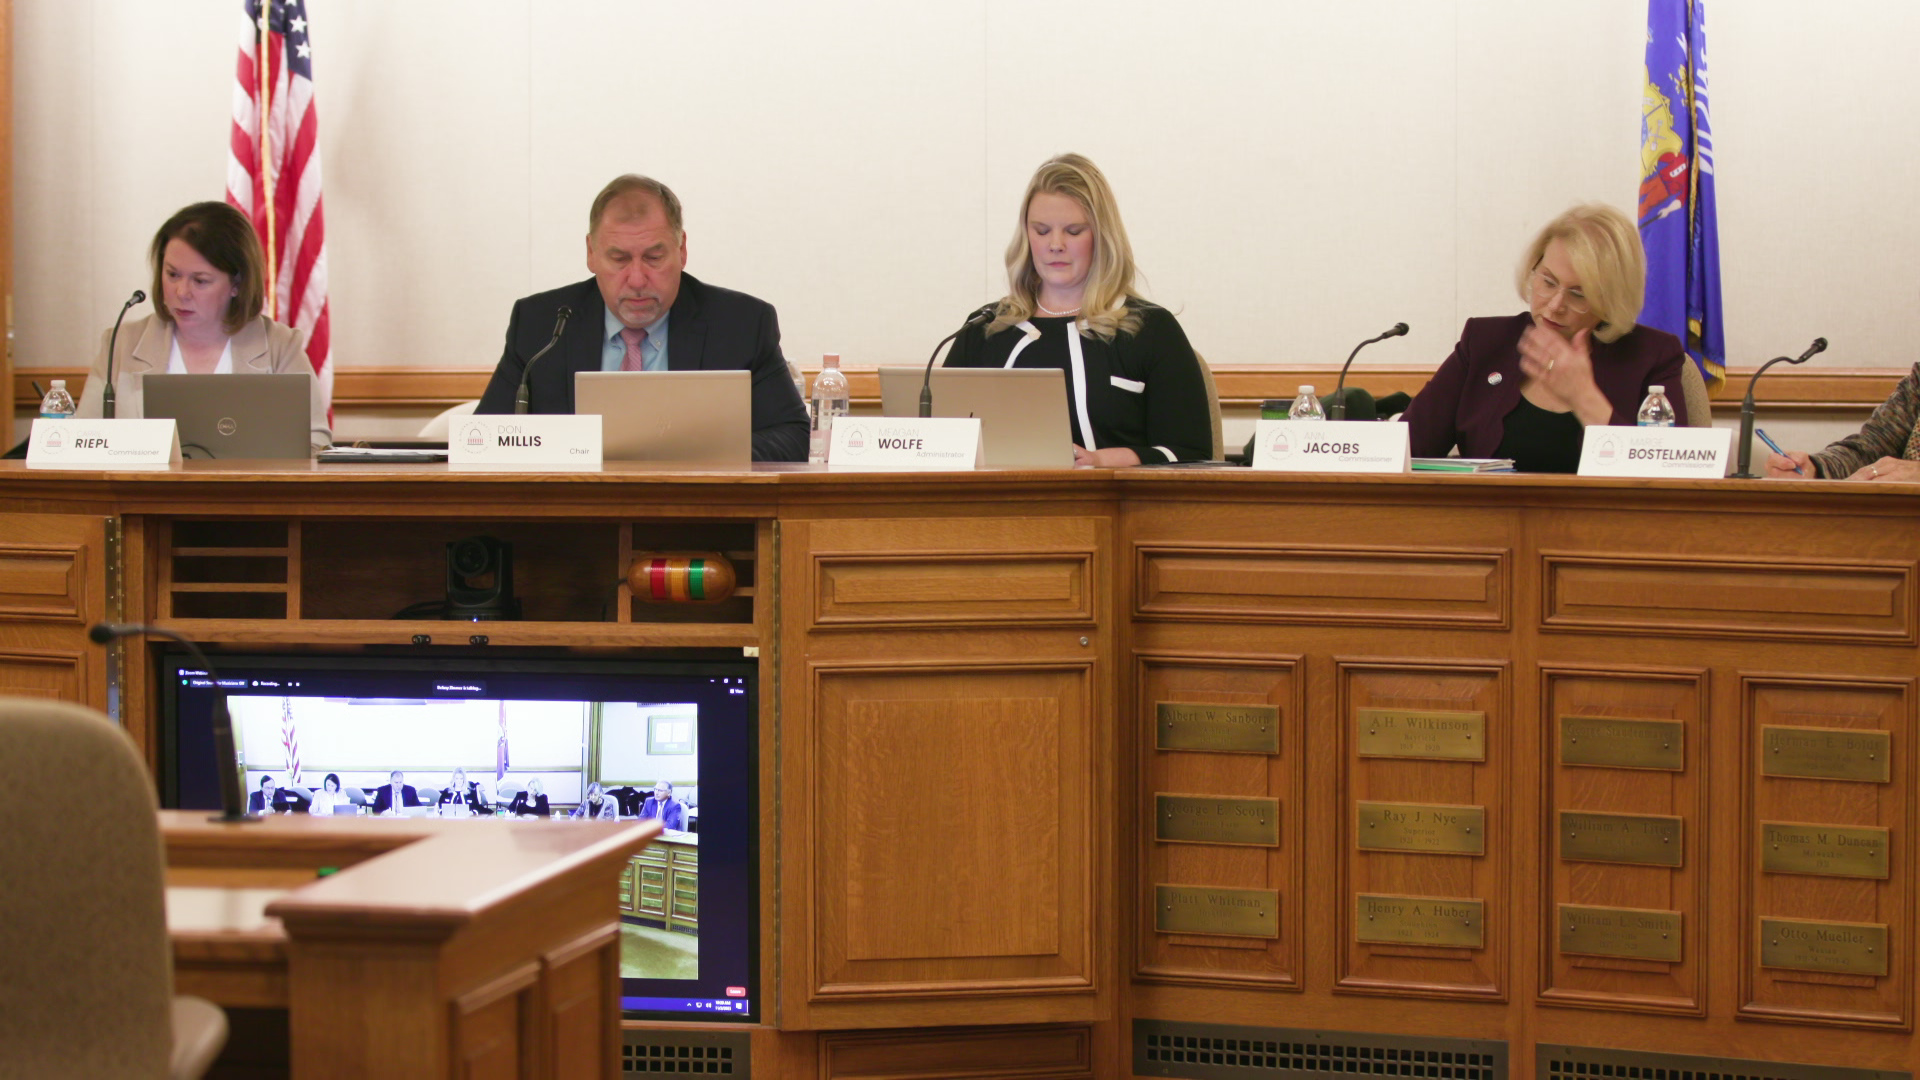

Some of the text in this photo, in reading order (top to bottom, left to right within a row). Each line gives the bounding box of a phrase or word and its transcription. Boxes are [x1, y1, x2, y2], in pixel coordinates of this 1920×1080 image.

[497, 425, 522, 434] DON
[878, 427, 920, 437] MEAGAN
[1303, 431, 1326, 441] ANN
[75, 438, 109, 449] RIEPL
[498, 436, 542, 447] MILLIS
[878, 438, 923, 450] WOLFE
[1303, 443, 1360, 454] JACOBS
[1628, 448, 1717, 461] BOSTELMANN
[1338, 455, 1393, 463] Commissioner
[1661, 461, 1716, 469] Commissioner
[1165, 710, 1270, 725] Albert W. Sanborn
[1406, 717, 1470, 731] Wilkinson
[1166, 803, 1209, 817] George
[1235, 805, 1266, 817] Scott
[1383, 809, 1457, 826] Ray J. Nye
[1568, 818, 1613, 833] William
[1770, 831, 1811, 844] Thomas
[1837, 834, 1880, 848] Duncan
[1170, 892, 1261, 908] Platt Whitman
[1367, 902, 1471, 918] Henry A. Huber
[1567, 911, 1612, 926] William
[1637, 917, 1672, 931] Smith
[1780, 927, 1864, 944] Otto Mueller
